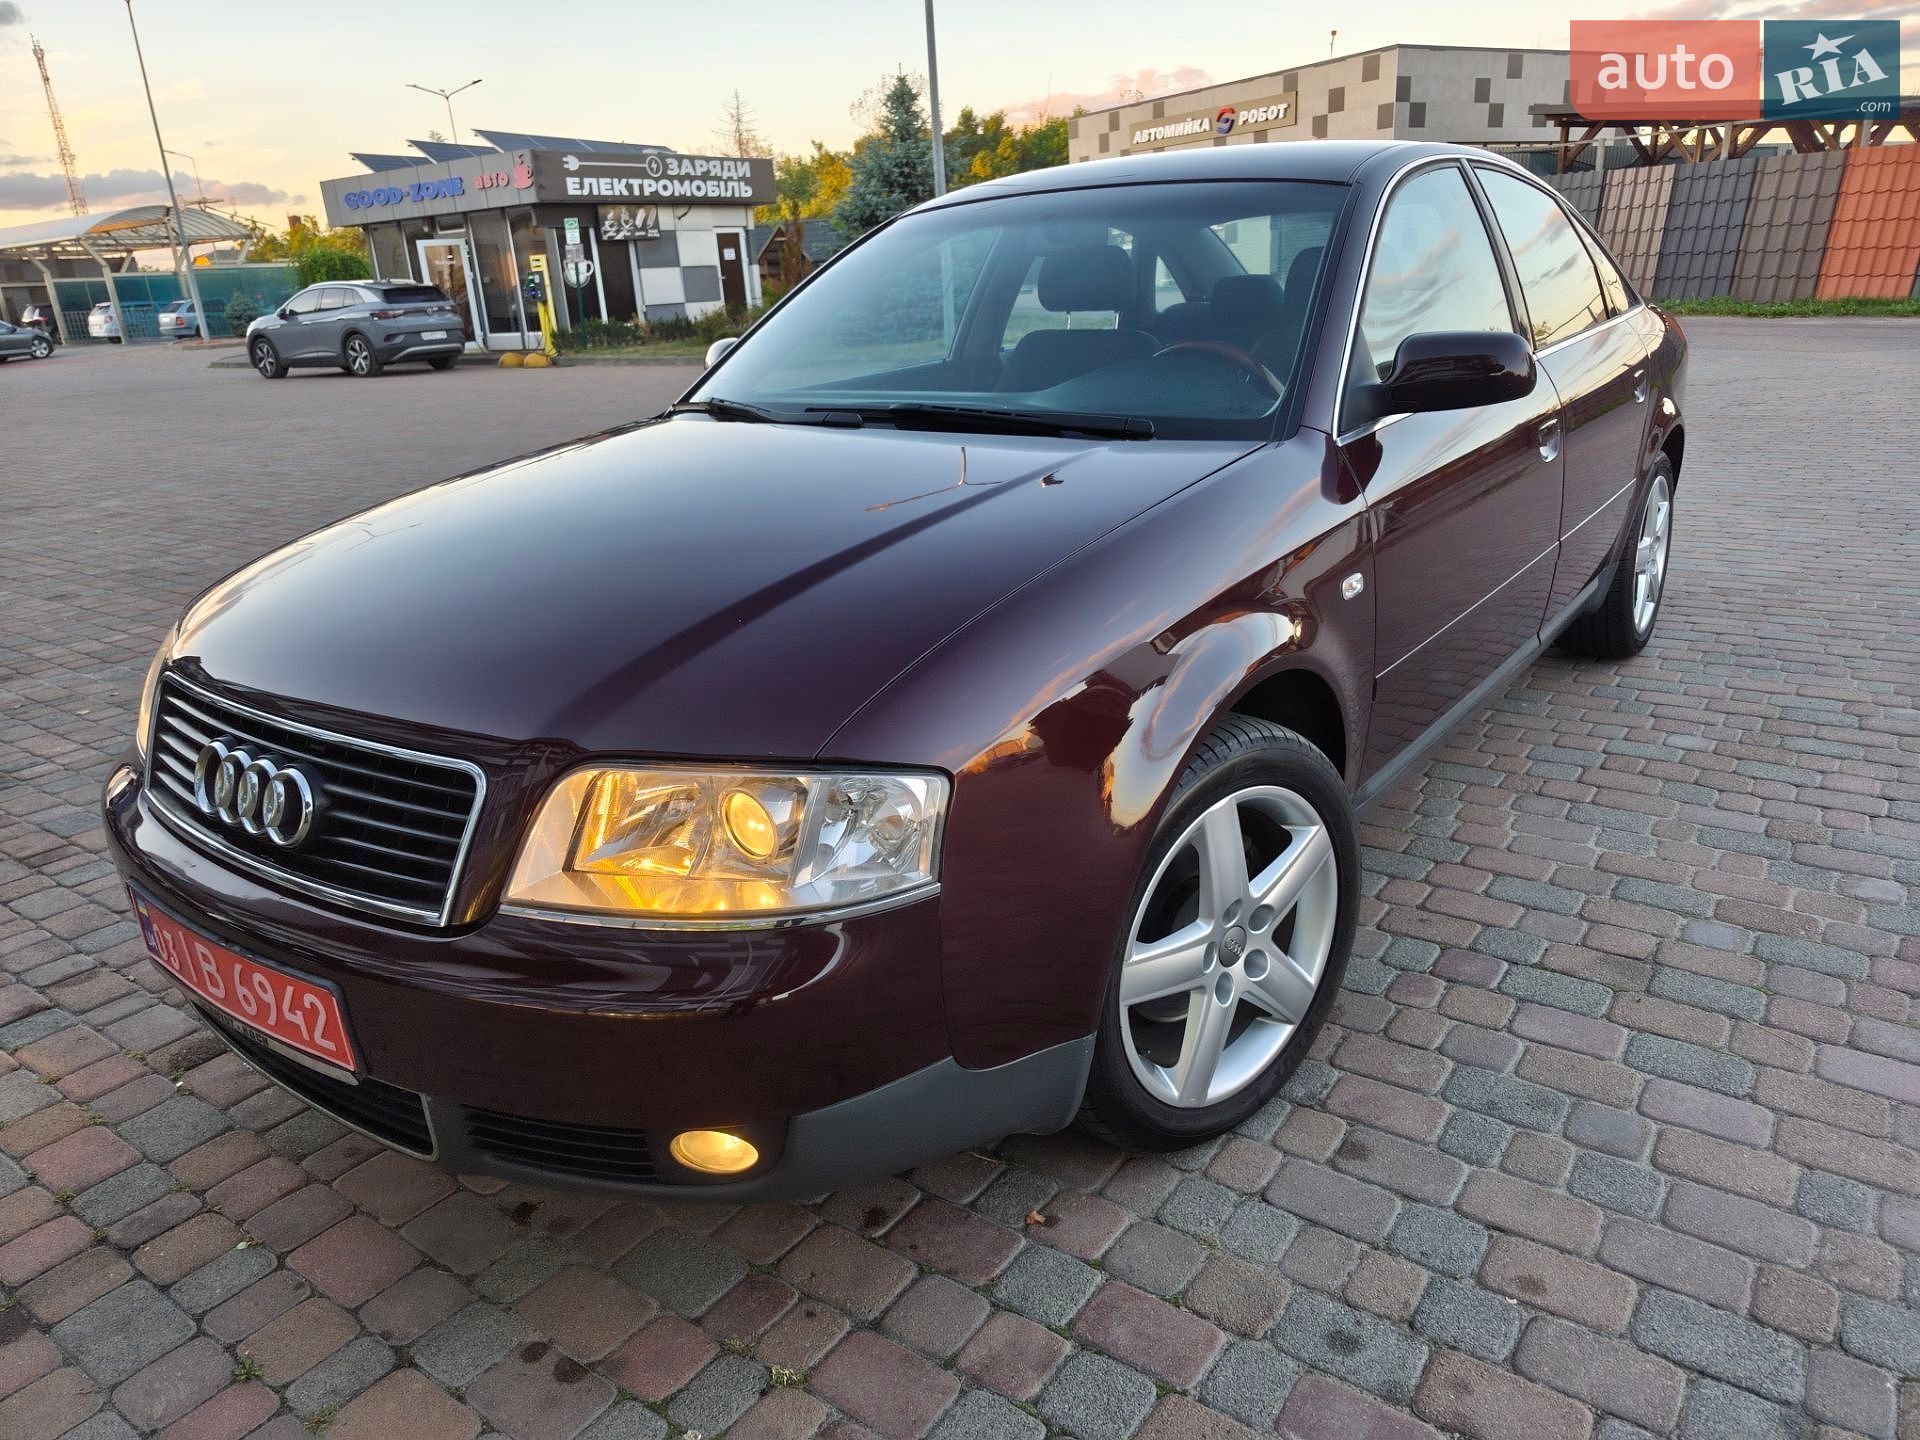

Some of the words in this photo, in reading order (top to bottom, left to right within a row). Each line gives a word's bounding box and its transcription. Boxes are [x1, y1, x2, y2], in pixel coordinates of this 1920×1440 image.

[1133, 117, 1211, 144] АВТОМИЙКА
[1238, 103, 1288, 126] РОБОТ
[665, 157, 752, 180] ЗАРЯДИ
[344, 176, 465, 210] GOOD-ZONE
[565, 177, 753, 198] ЕЛЕКТРОМОБІЛЬ
[233, 963, 337, 1052] 6942
